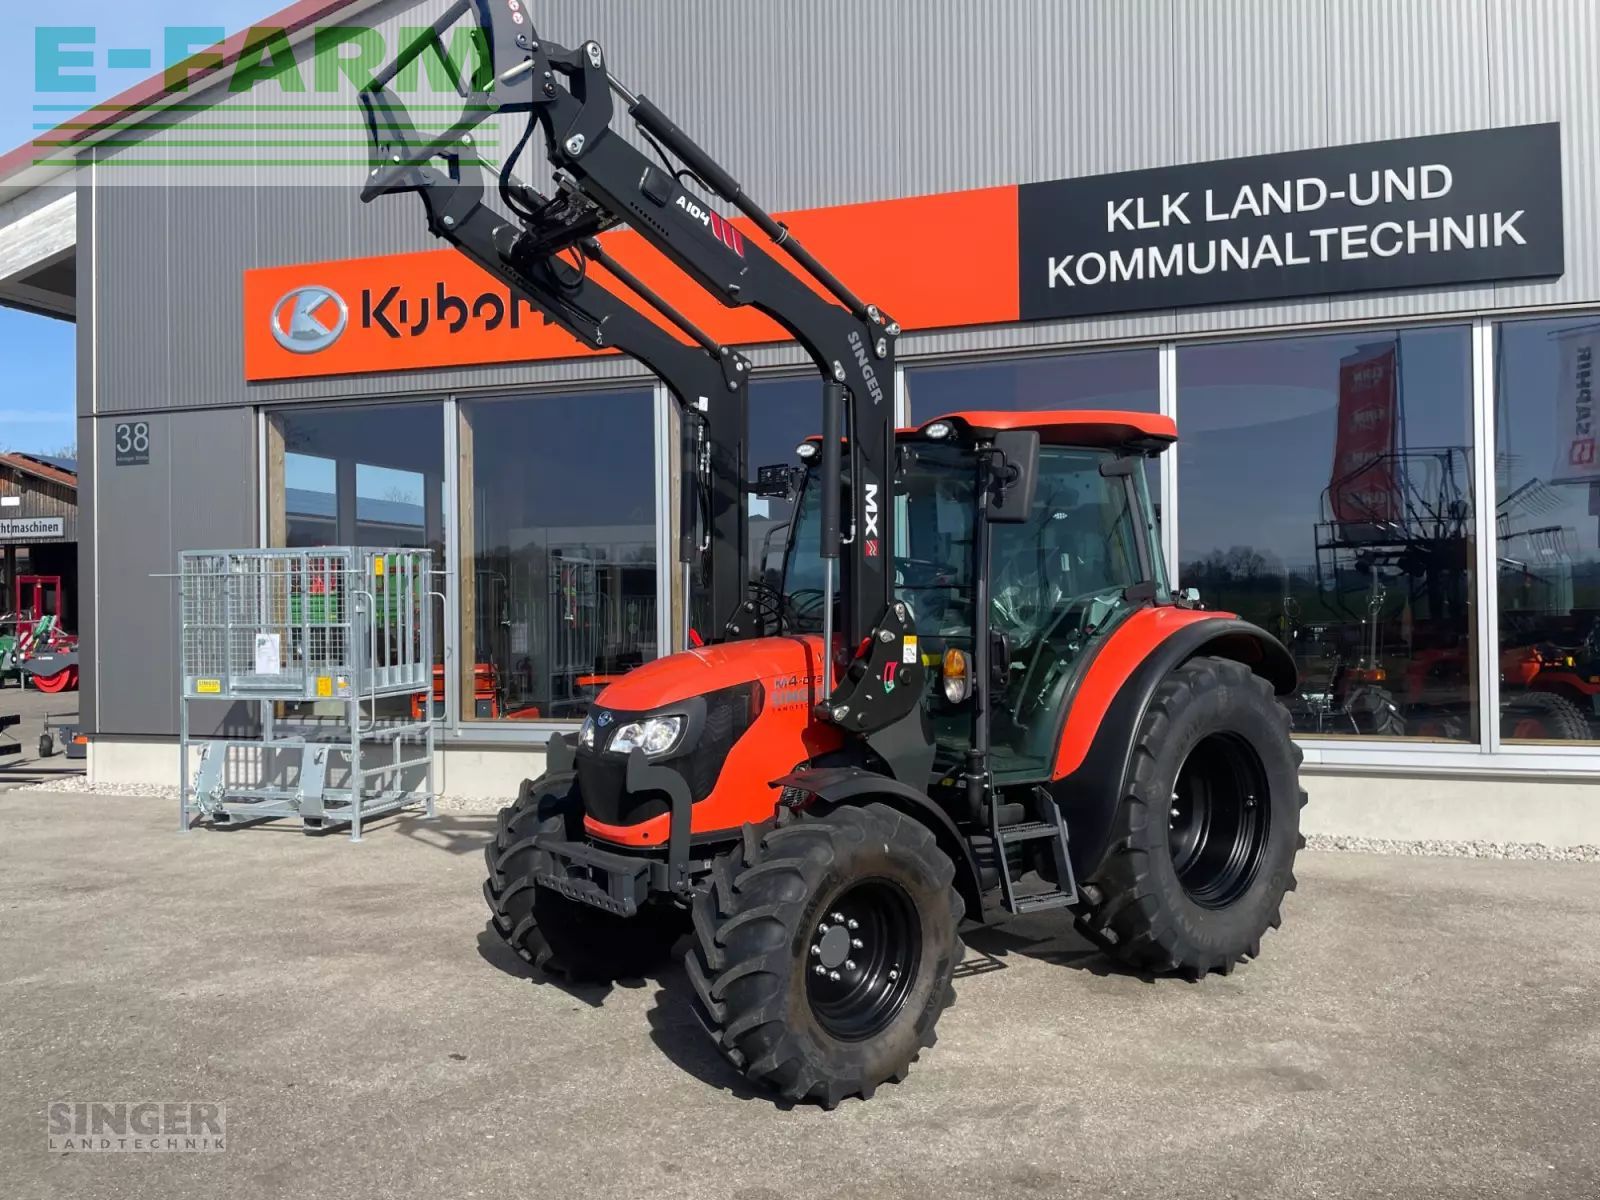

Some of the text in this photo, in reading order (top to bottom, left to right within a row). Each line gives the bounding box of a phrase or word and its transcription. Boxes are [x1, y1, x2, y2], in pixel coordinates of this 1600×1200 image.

[676, 196, 710, 226] A104
[1107, 164, 1453, 232] KLK LAND-UND
[1048, 210, 1527, 288] KOMMUNALTECHNIK
[361, 281, 556, 338] Kubot
[848, 331, 883, 405] SINGER
[116, 423, 149, 453] 38
[0, 521, 59, 533] htmaschinen
[865, 484, 878, 537] MX
